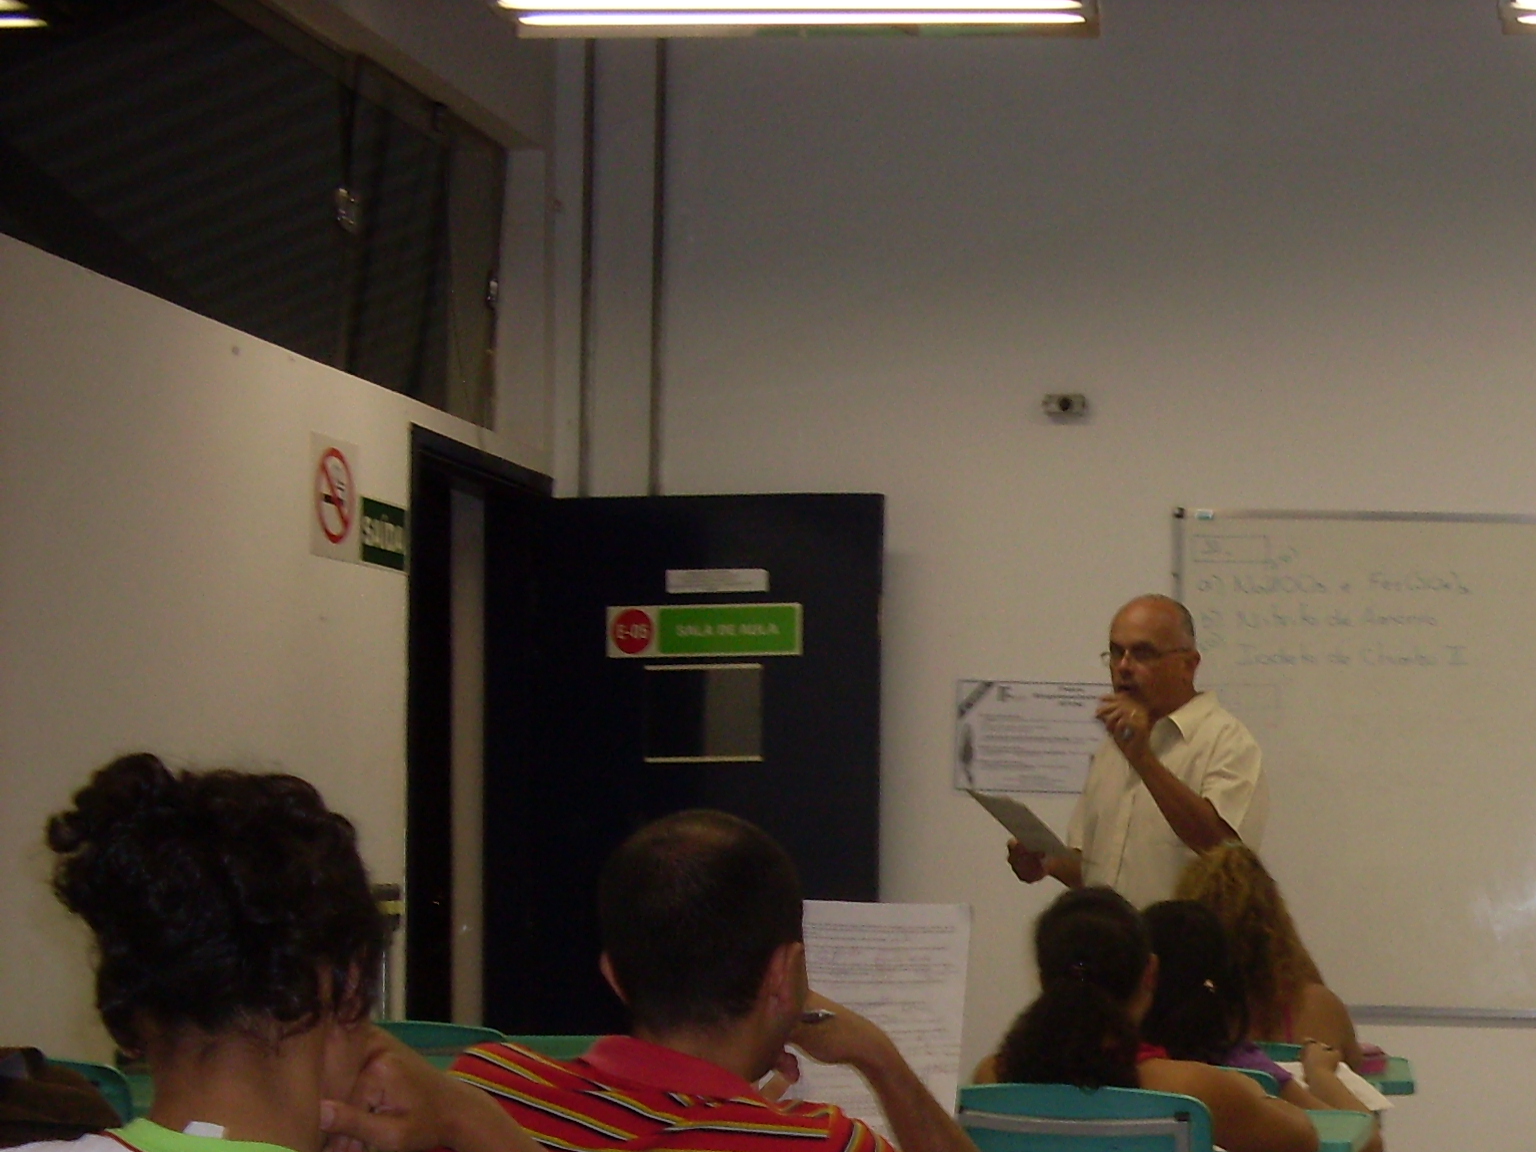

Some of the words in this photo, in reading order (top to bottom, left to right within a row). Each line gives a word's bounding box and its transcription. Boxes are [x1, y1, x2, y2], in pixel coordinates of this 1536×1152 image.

[676, 624, 714, 637] SALA
[717, 624, 737, 636] DE
[739, 622, 781, 636] AULA
